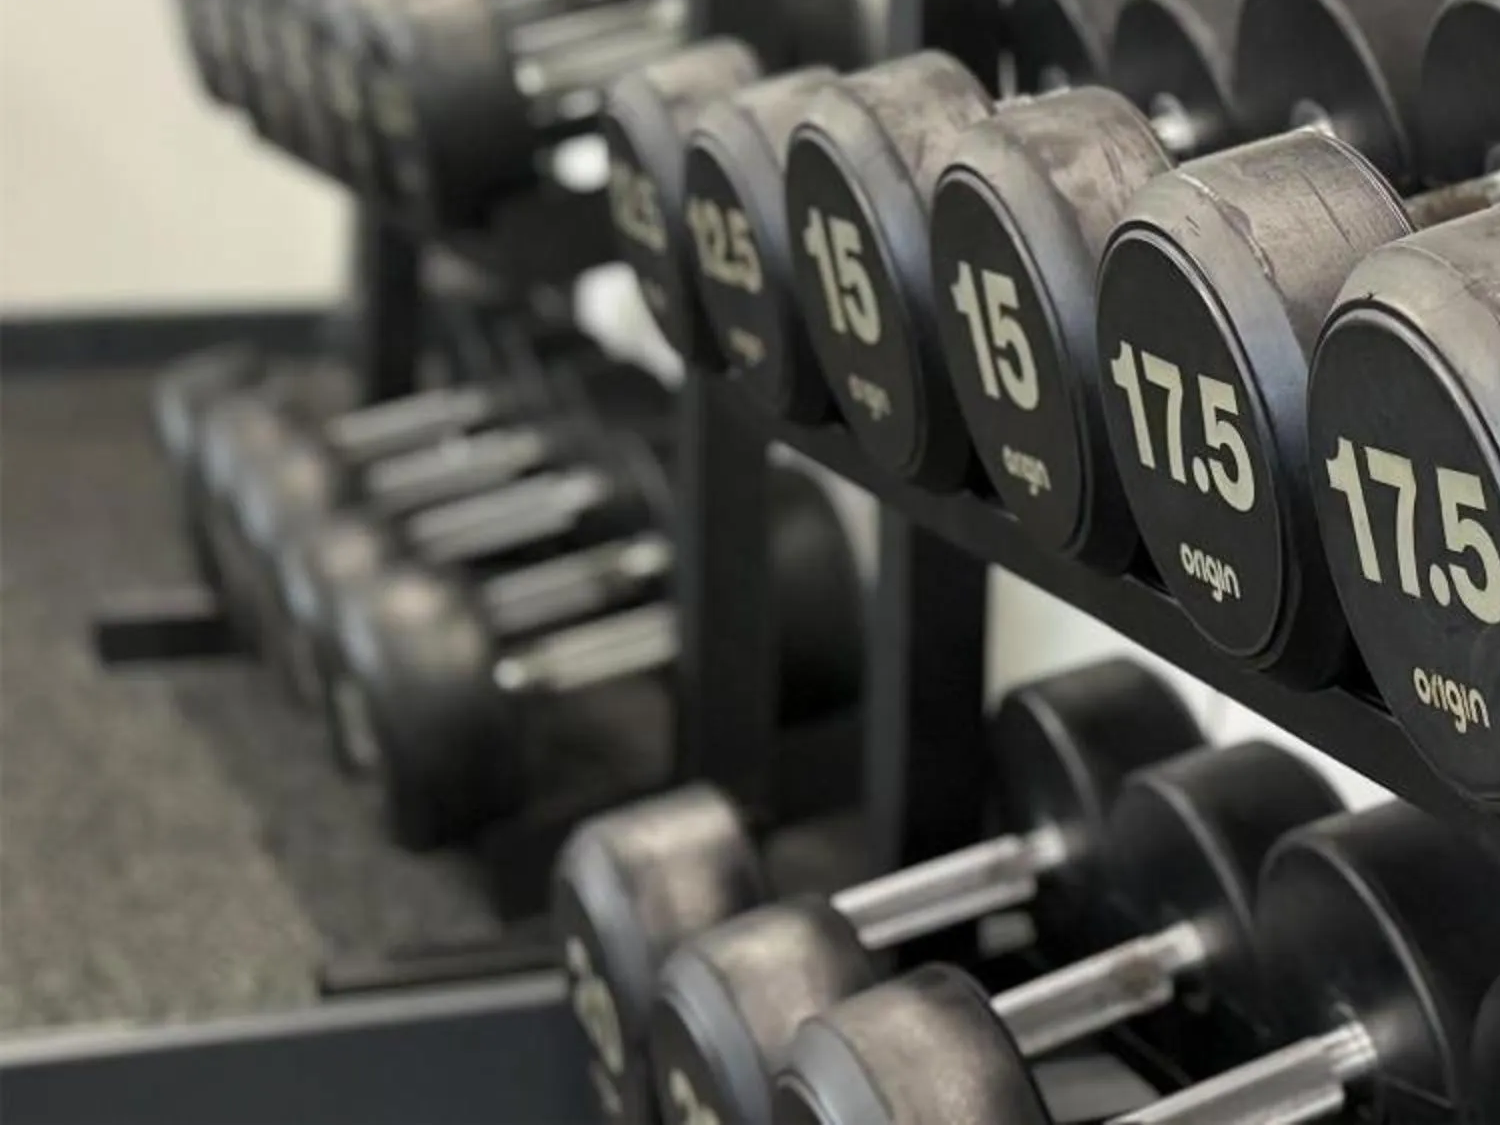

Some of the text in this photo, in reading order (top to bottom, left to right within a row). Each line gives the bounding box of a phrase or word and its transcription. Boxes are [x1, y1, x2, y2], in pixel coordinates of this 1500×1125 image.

[804, 208, 880, 345] 15
[950, 261, 1039, 410] 15
[1110, 341, 1255, 512] 17.5
[1180, 542, 1240, 603] origin
[1413, 667, 1491, 735] origin
